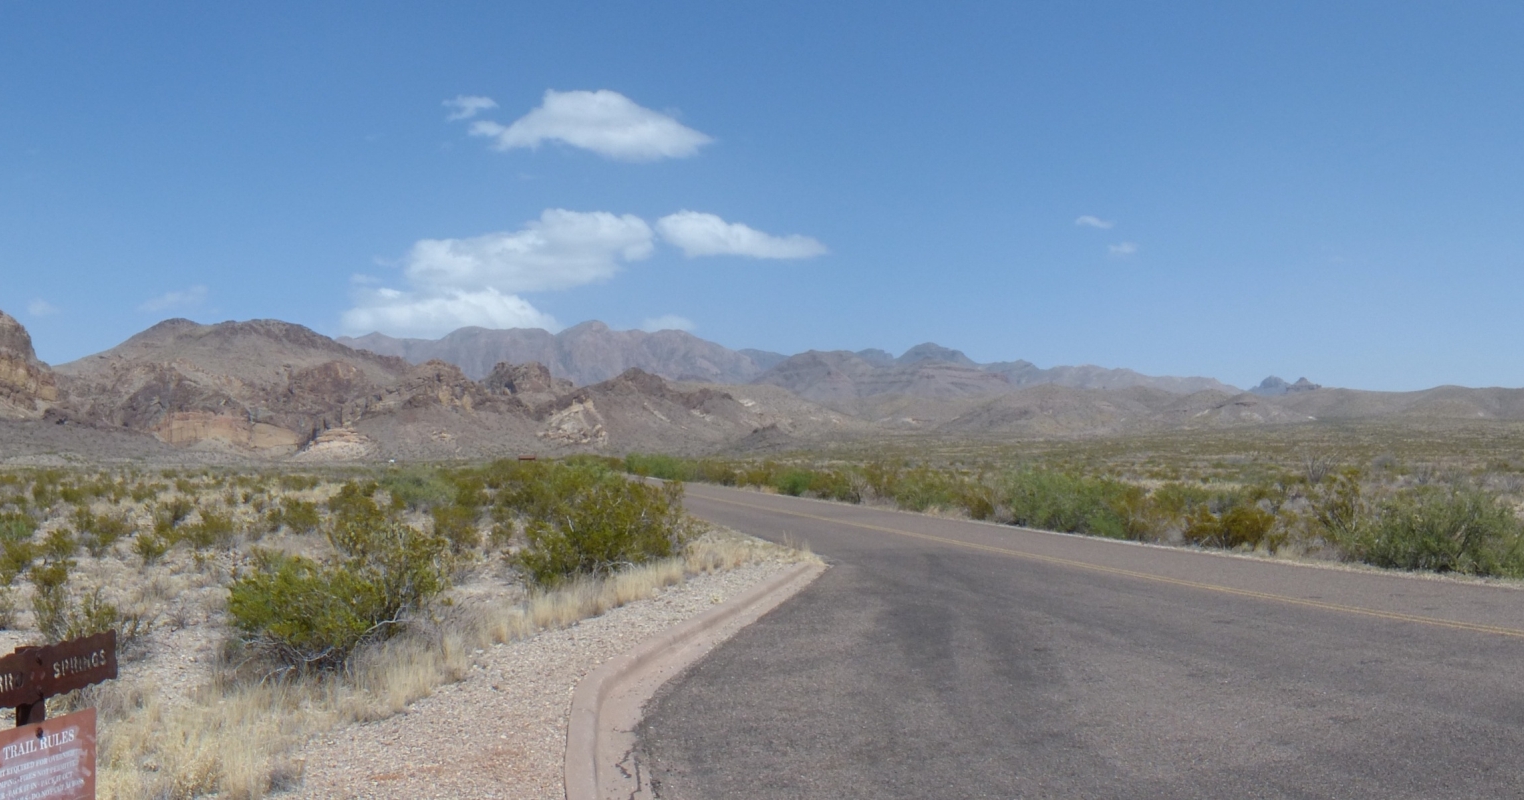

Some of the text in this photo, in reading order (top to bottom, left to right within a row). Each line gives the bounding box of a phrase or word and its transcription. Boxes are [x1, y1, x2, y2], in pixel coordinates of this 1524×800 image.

[53, 649, 106, 679] SPRINGS
[2, 729, 75, 760] TRAIL RULES
